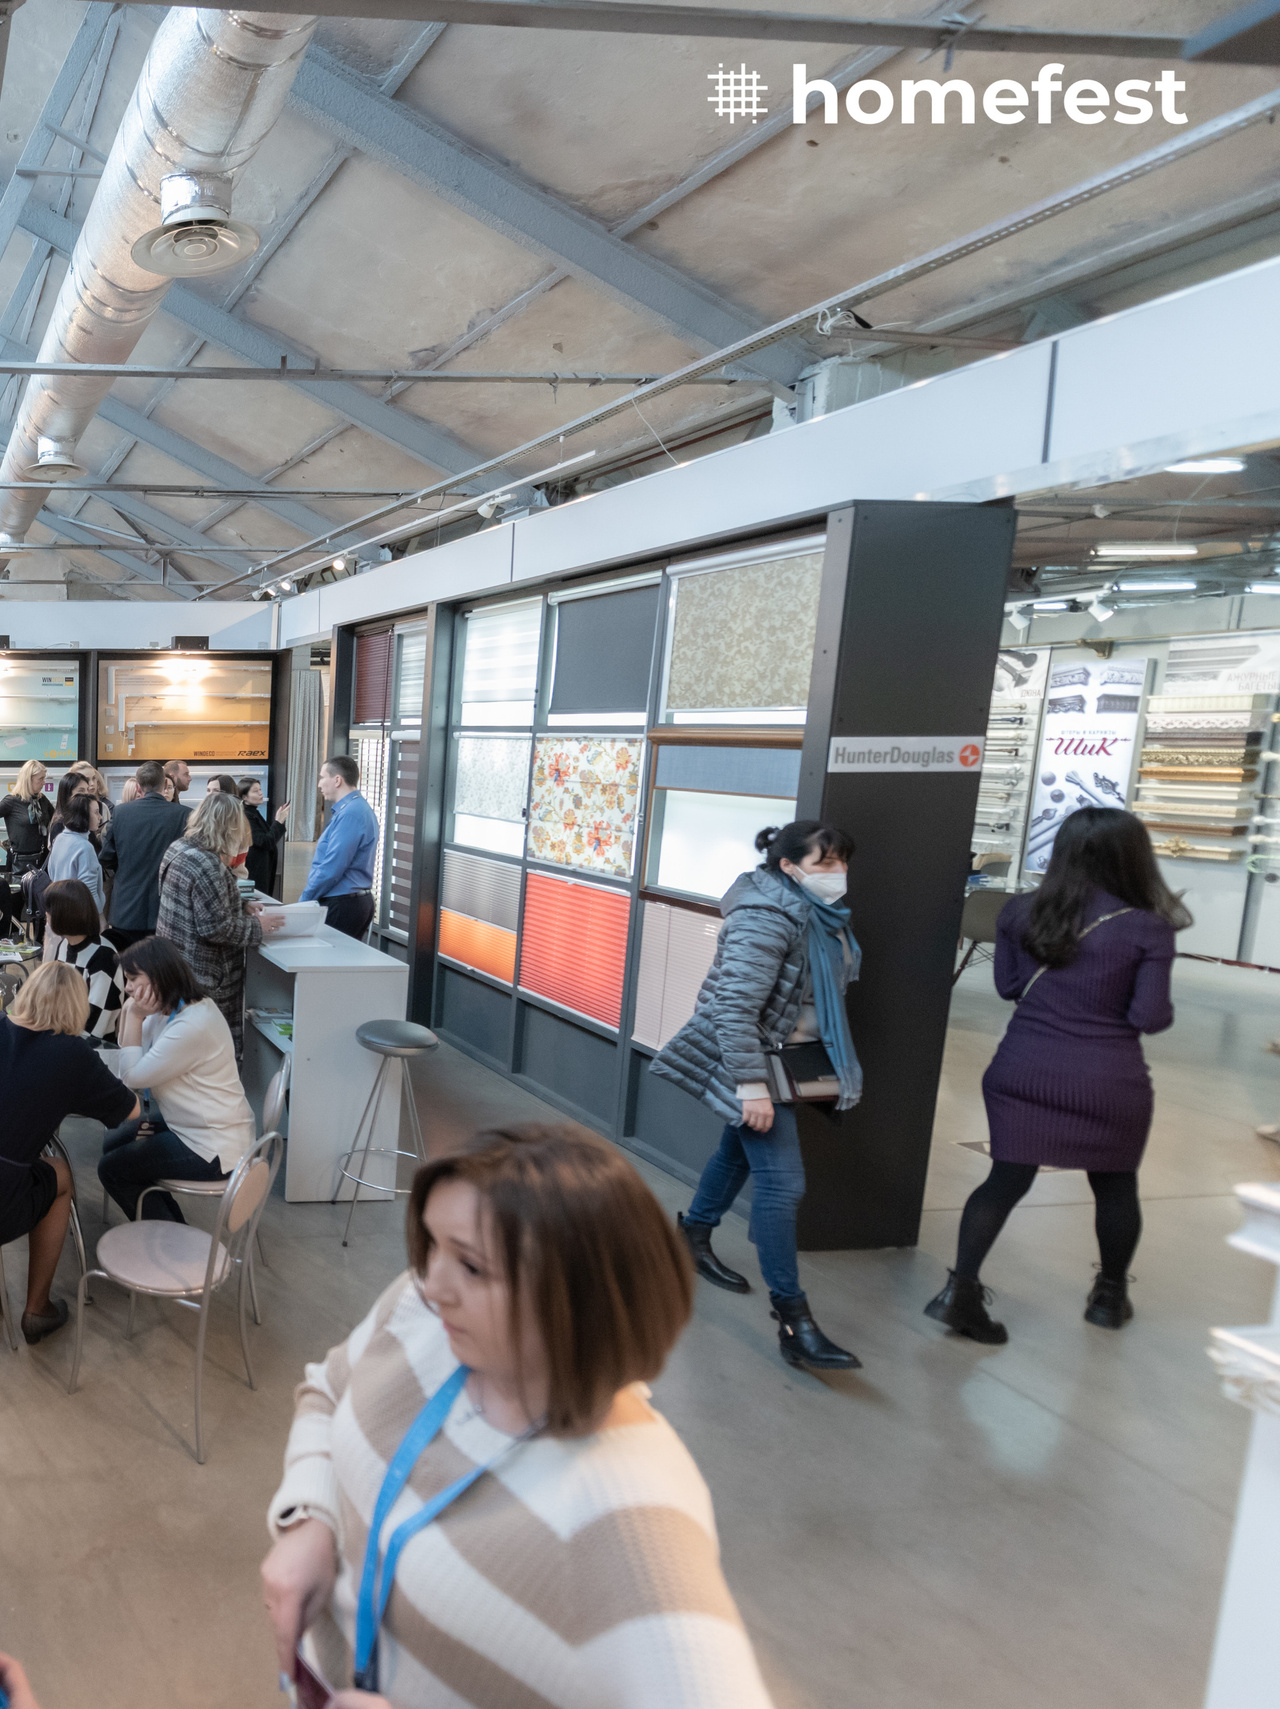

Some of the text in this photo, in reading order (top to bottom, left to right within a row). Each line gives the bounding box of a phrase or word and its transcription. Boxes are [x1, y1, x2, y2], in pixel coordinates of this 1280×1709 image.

[1226, 671, 1278, 682] АЖУРНЫЕ
[1237, 681, 1278, 691] БАГЕТЫ
[43, 749, 76, 759] somfy
